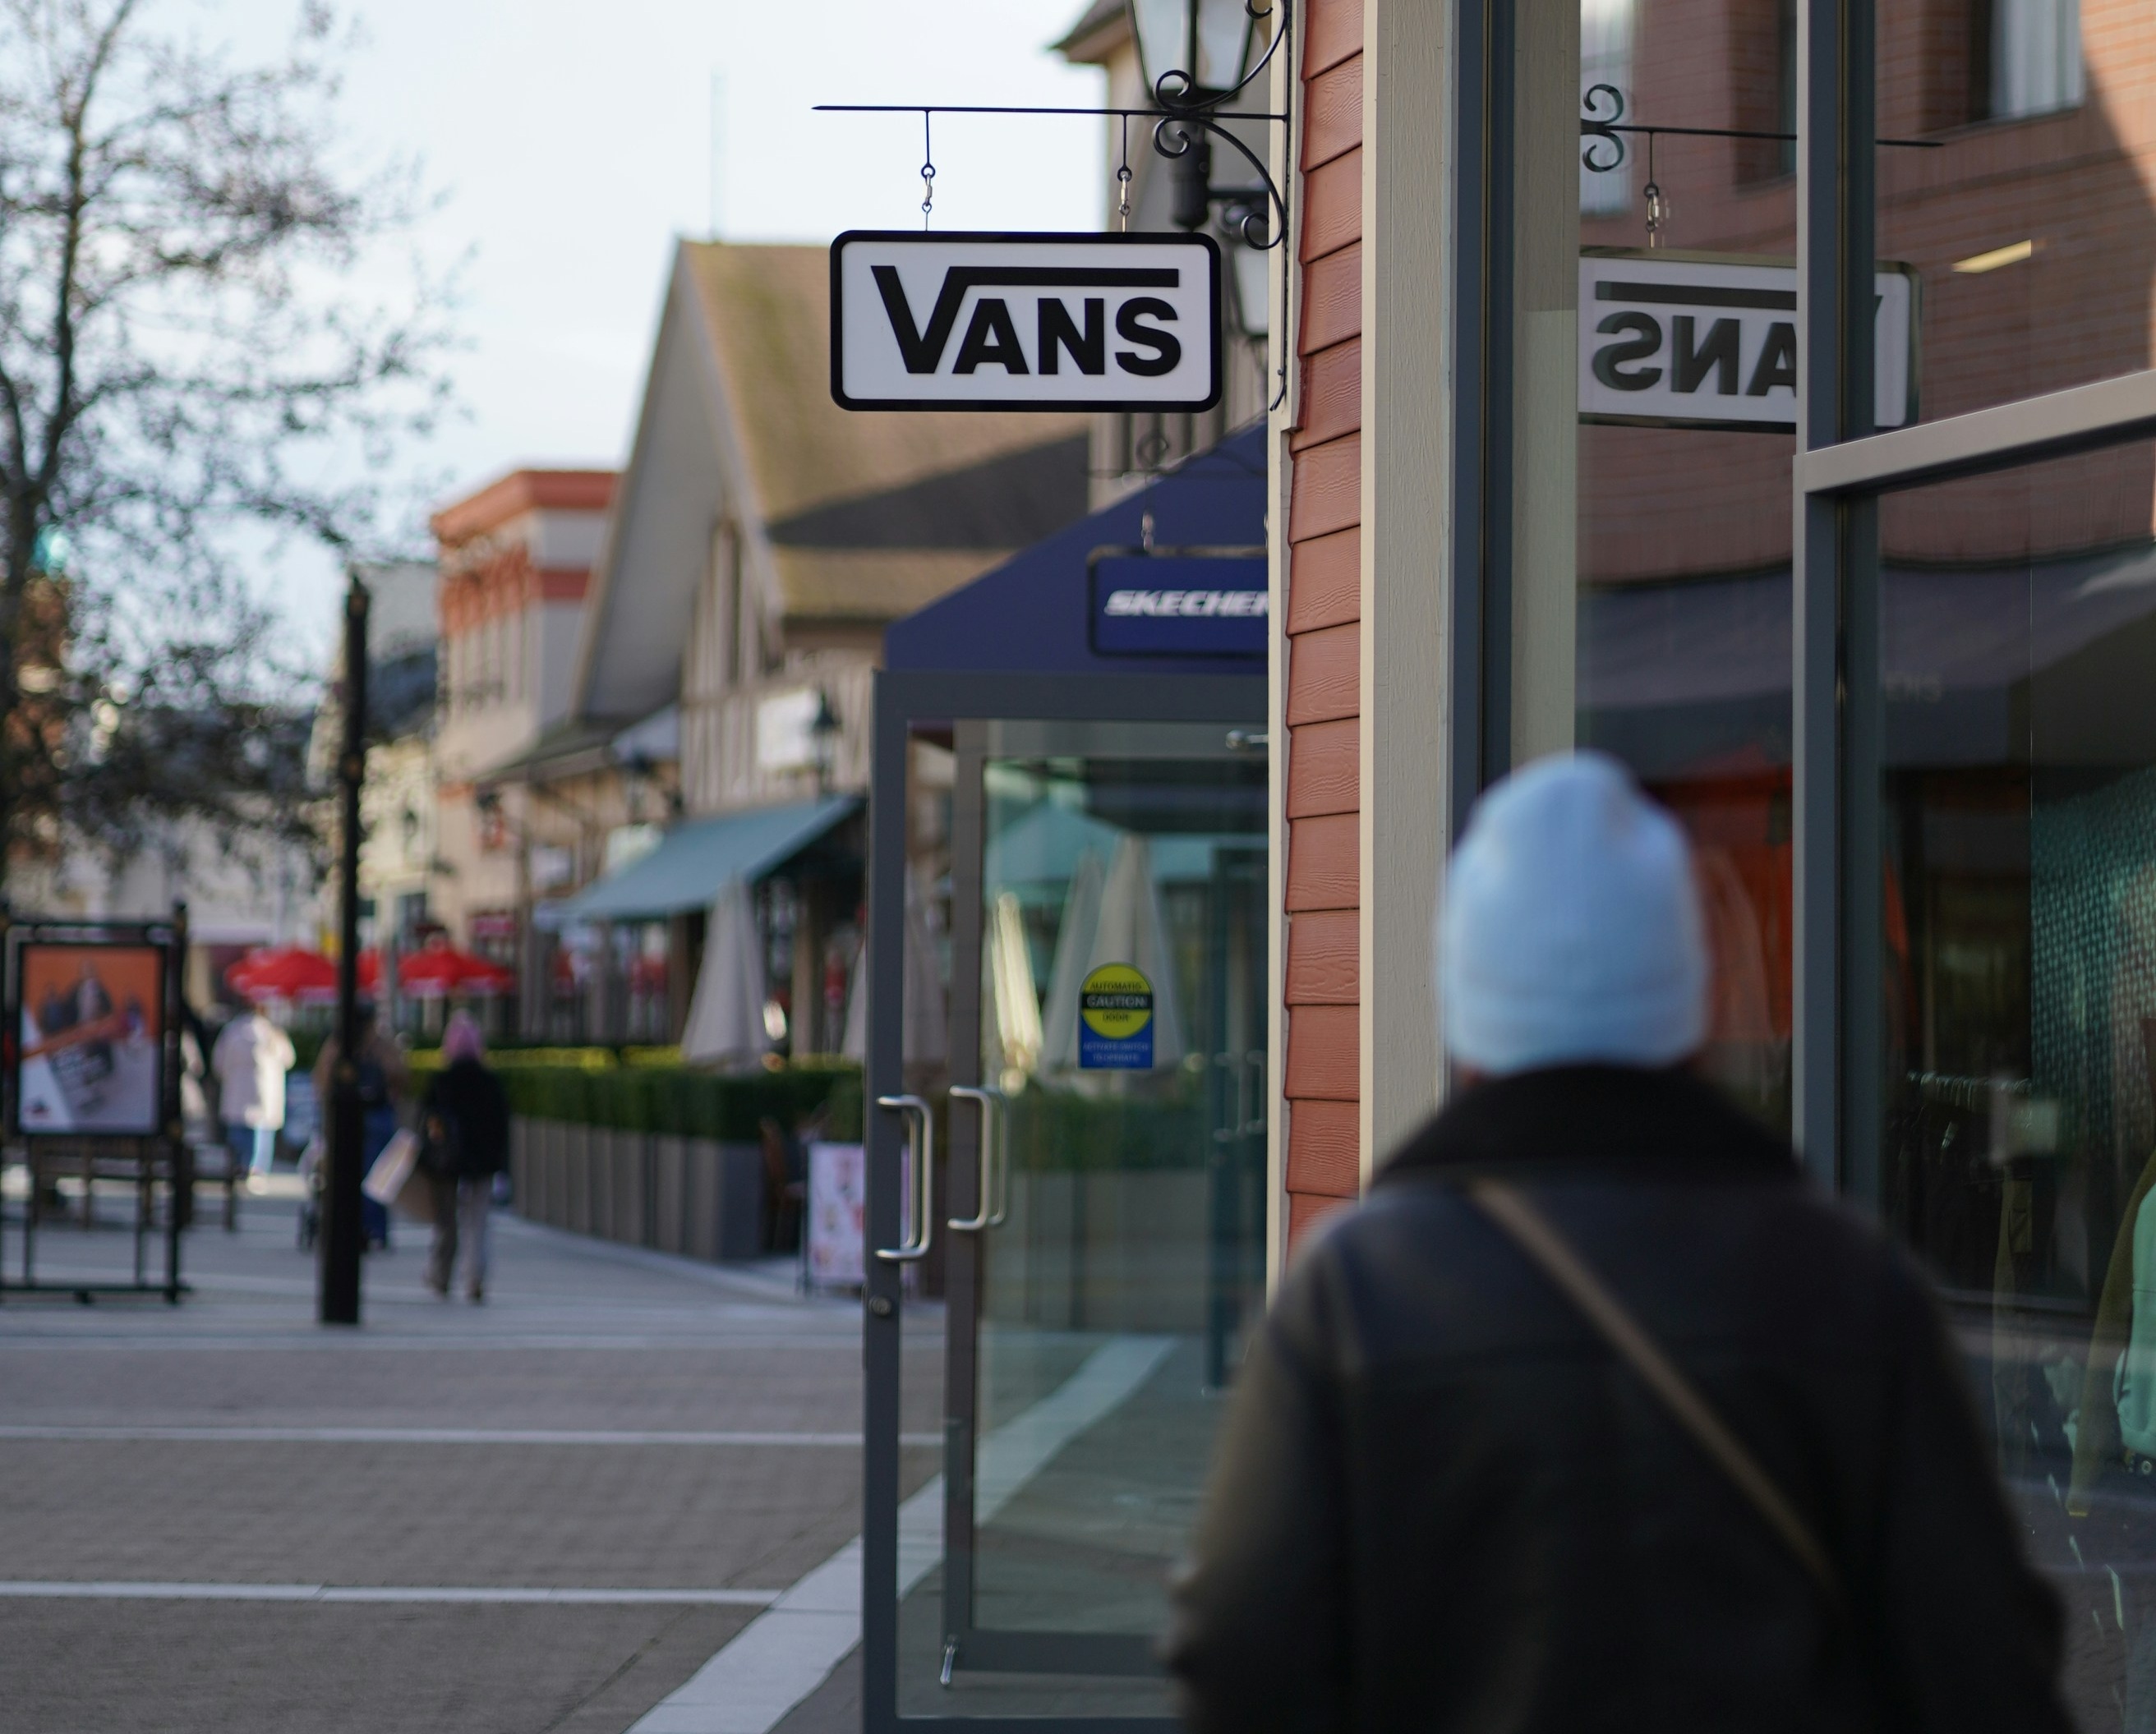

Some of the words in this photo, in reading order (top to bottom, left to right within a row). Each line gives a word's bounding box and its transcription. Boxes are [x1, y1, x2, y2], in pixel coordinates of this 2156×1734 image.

[871, 265, 1182, 376] VANS
[1090, 981, 1142, 991] AUTOMATIC
[1086, 995, 1149, 1008] CAUTION
[1102, 1014, 1129, 1023] DOOR
